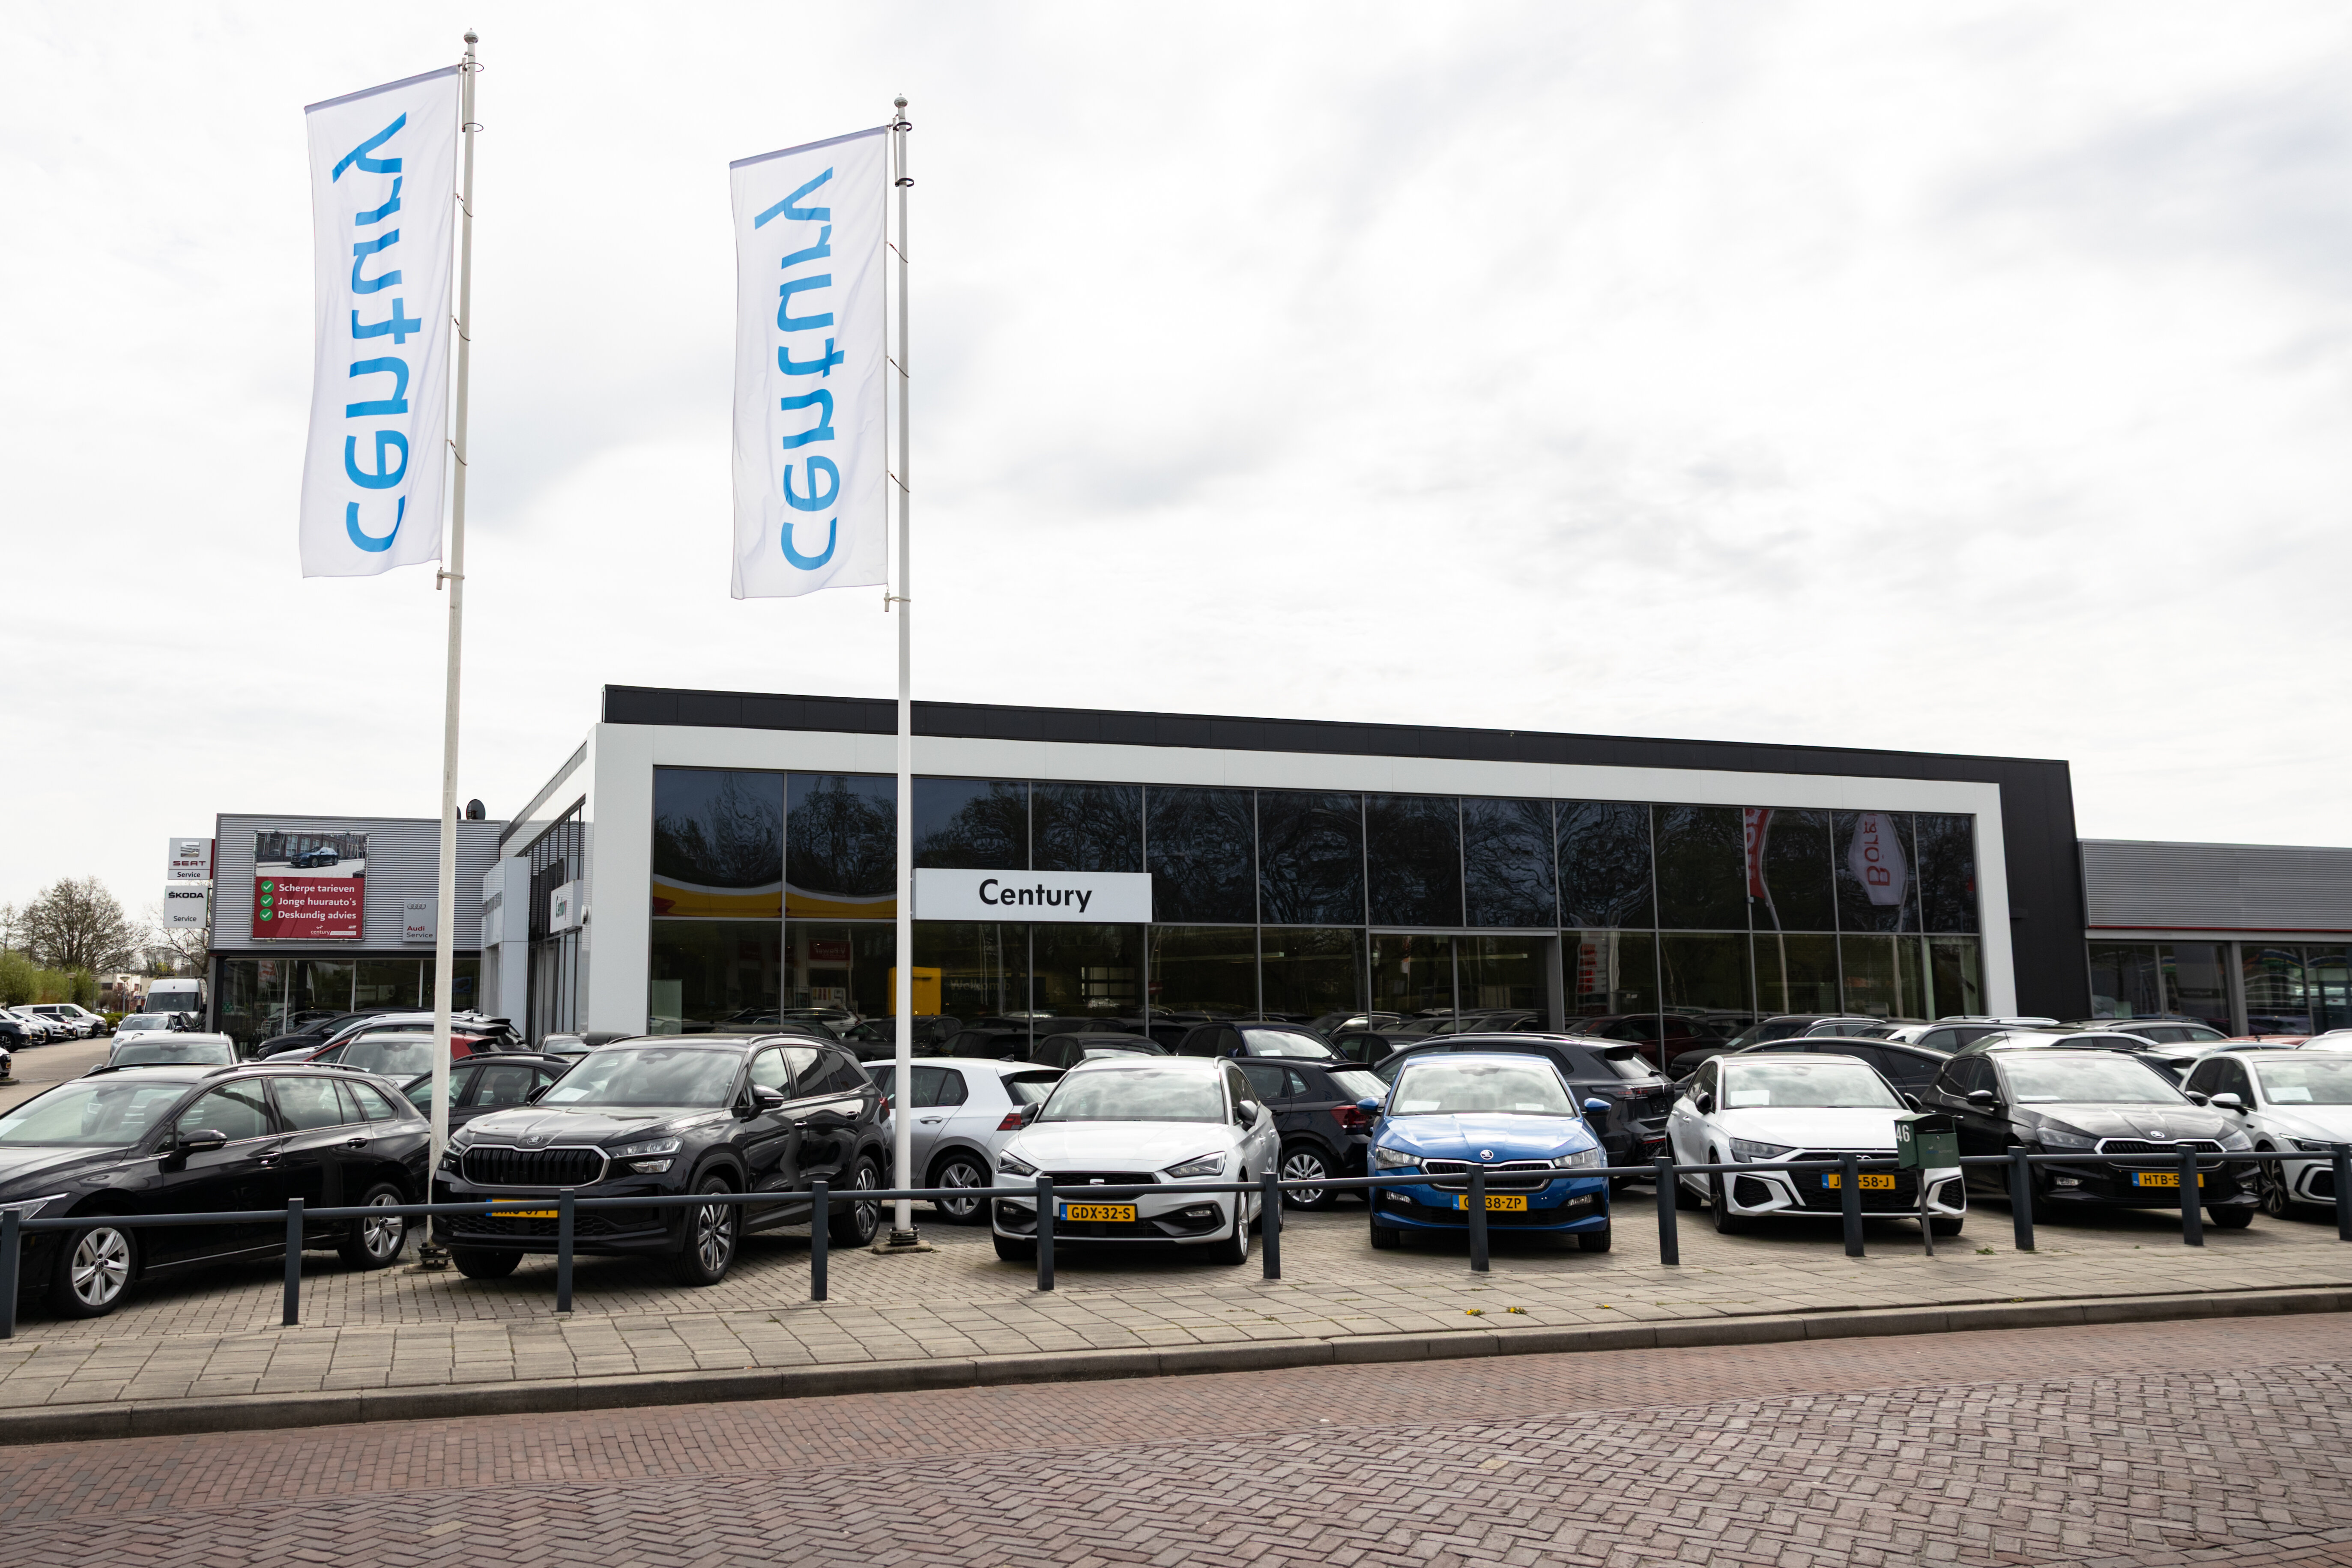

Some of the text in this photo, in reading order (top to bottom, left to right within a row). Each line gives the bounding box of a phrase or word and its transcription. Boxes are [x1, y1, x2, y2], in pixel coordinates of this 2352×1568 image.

[279, 884, 315, 894] Scherpe
[979, 879, 1092, 913] Century
[278, 897, 356, 907] Jonge huurauto's
[278, 911, 326, 921] Deskundig
[1896, 1125, 1910, 1142] 46
[1072, 1207, 1130, 1219] GDX-32-S
